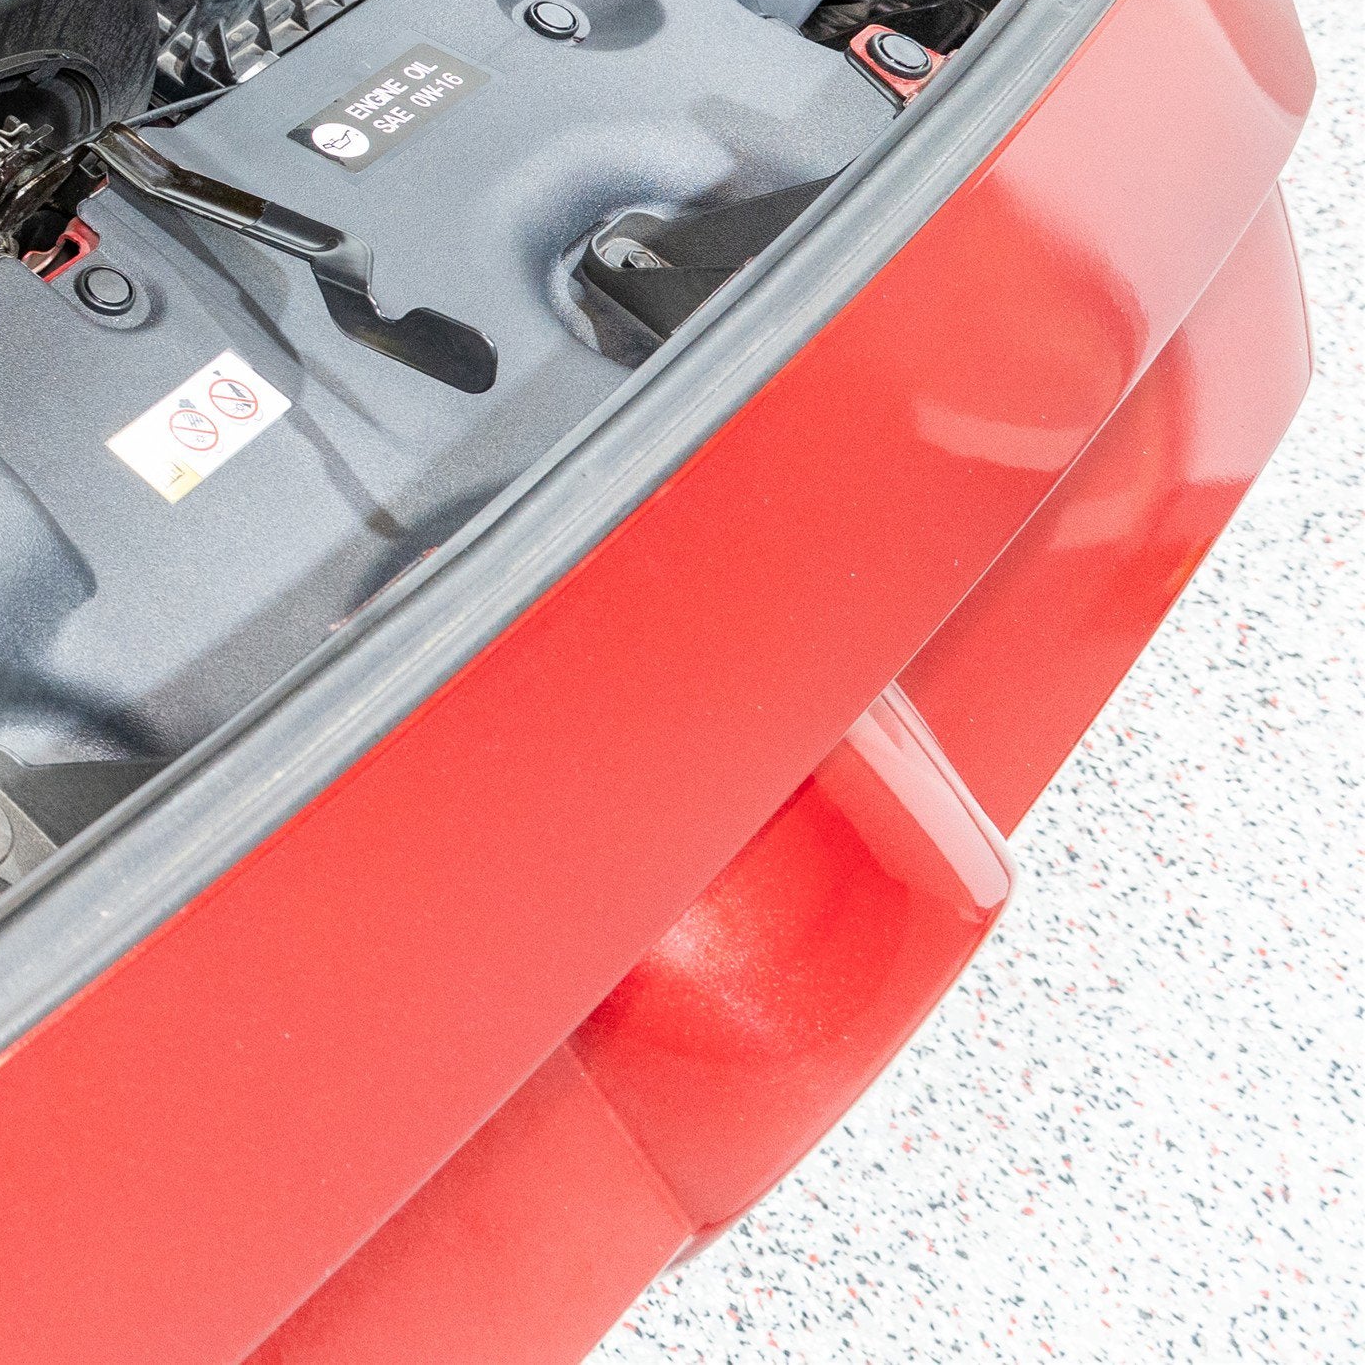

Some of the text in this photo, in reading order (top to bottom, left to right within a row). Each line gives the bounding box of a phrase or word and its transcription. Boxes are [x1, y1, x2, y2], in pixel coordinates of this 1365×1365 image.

[344, 61, 438, 120] ENGINE OIL
[373, 72, 464, 134] SAE 0W-16
